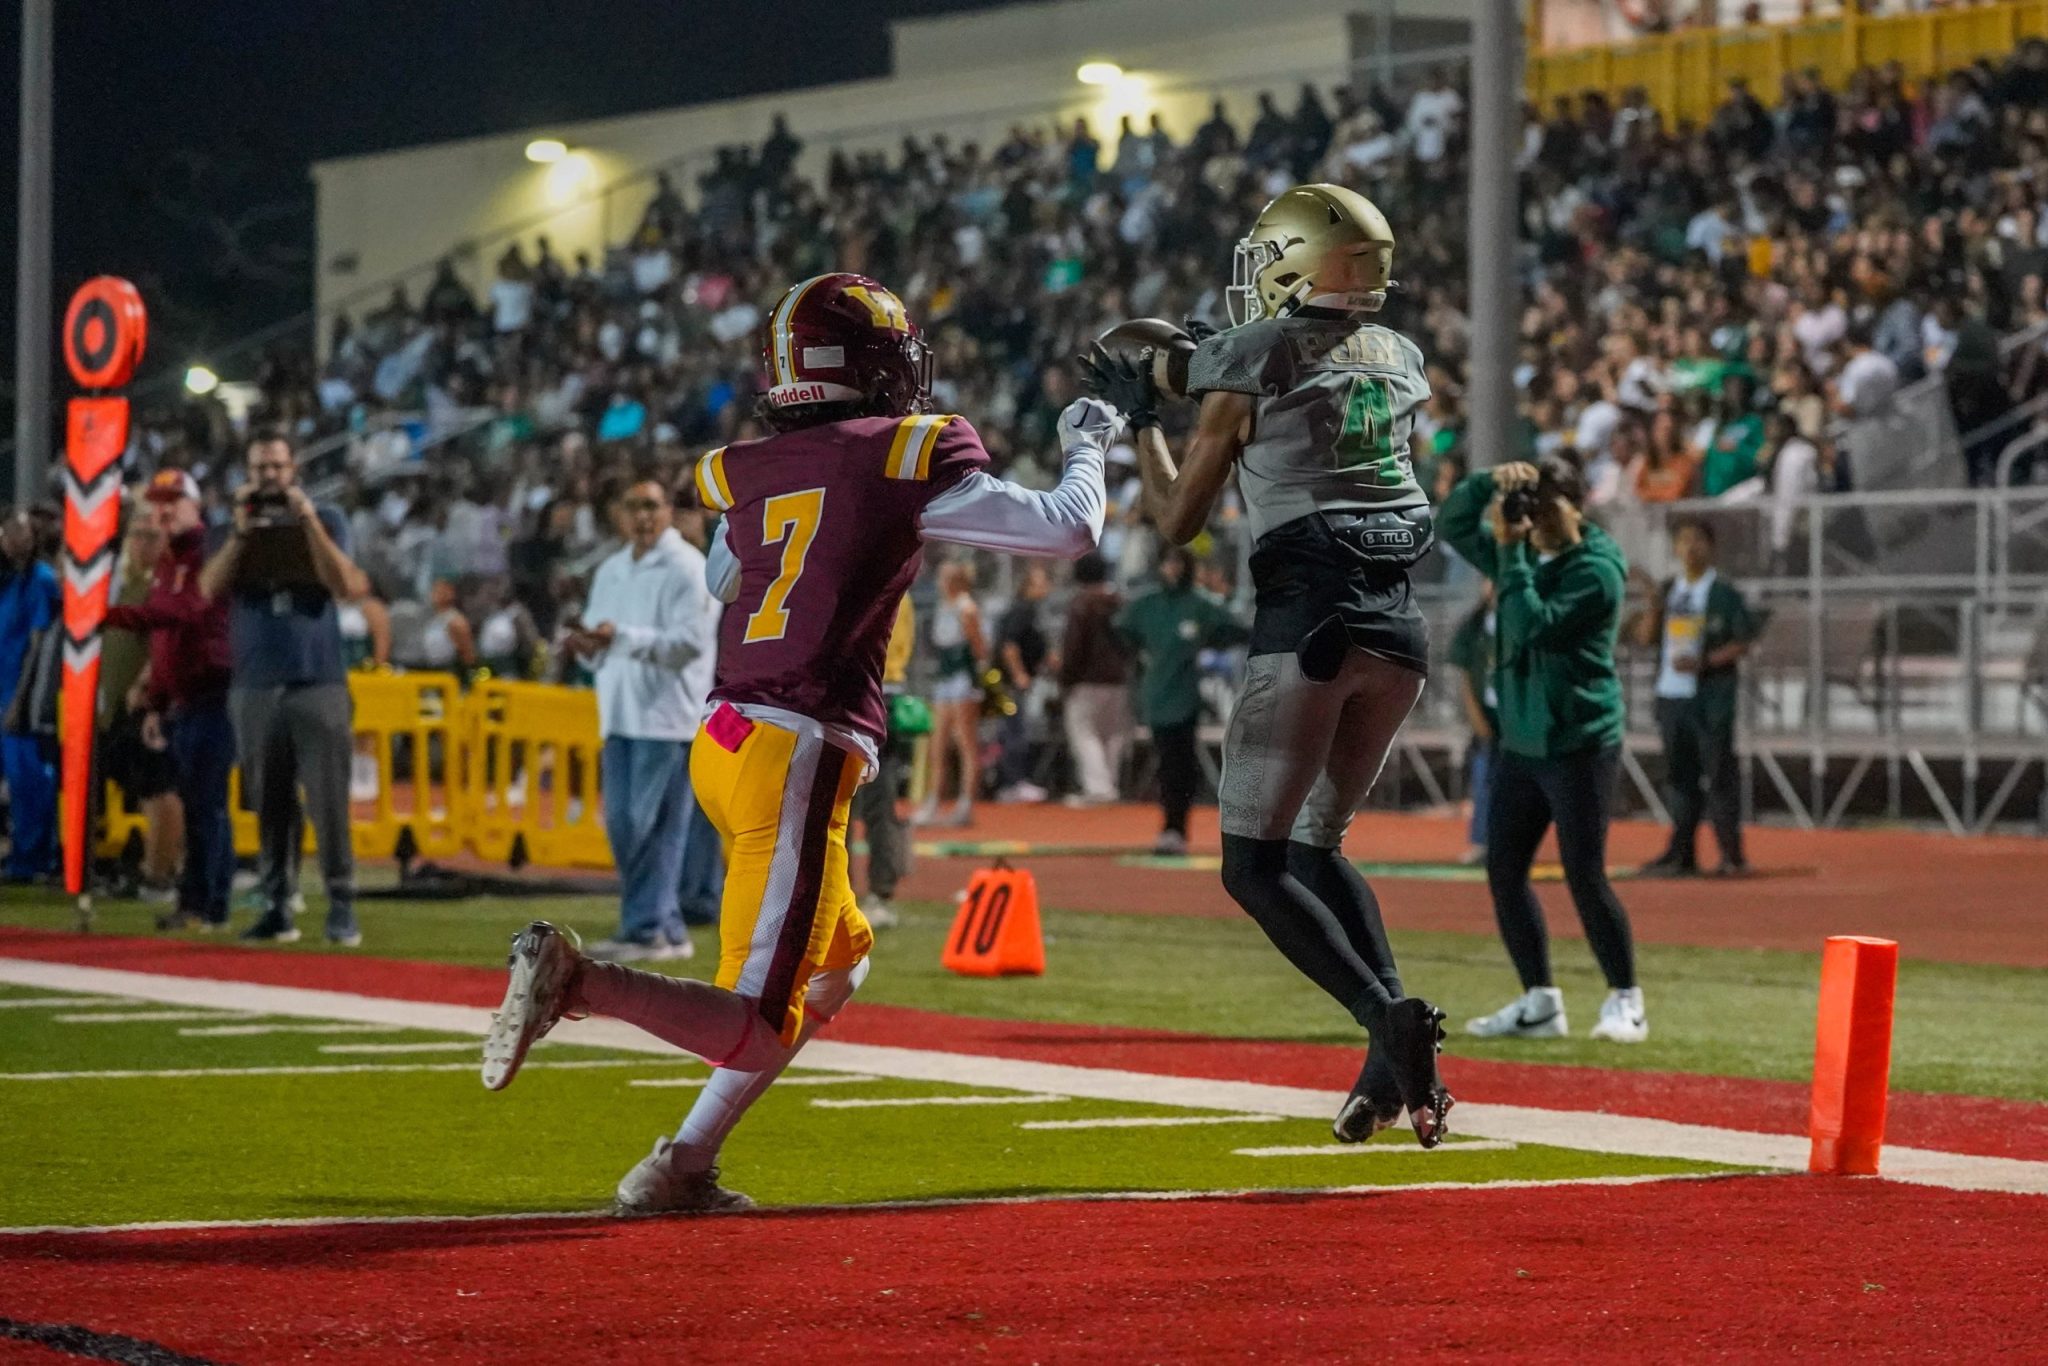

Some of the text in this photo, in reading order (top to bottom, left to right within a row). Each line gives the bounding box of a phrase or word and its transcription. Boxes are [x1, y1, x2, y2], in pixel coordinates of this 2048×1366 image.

[770, 385, 826, 407] Riddell
[779, 356, 786, 369] 7
[1331, 376, 1405, 487] 4
[742, 487, 826, 645] 7
[955, 882, 1012, 956] 10
